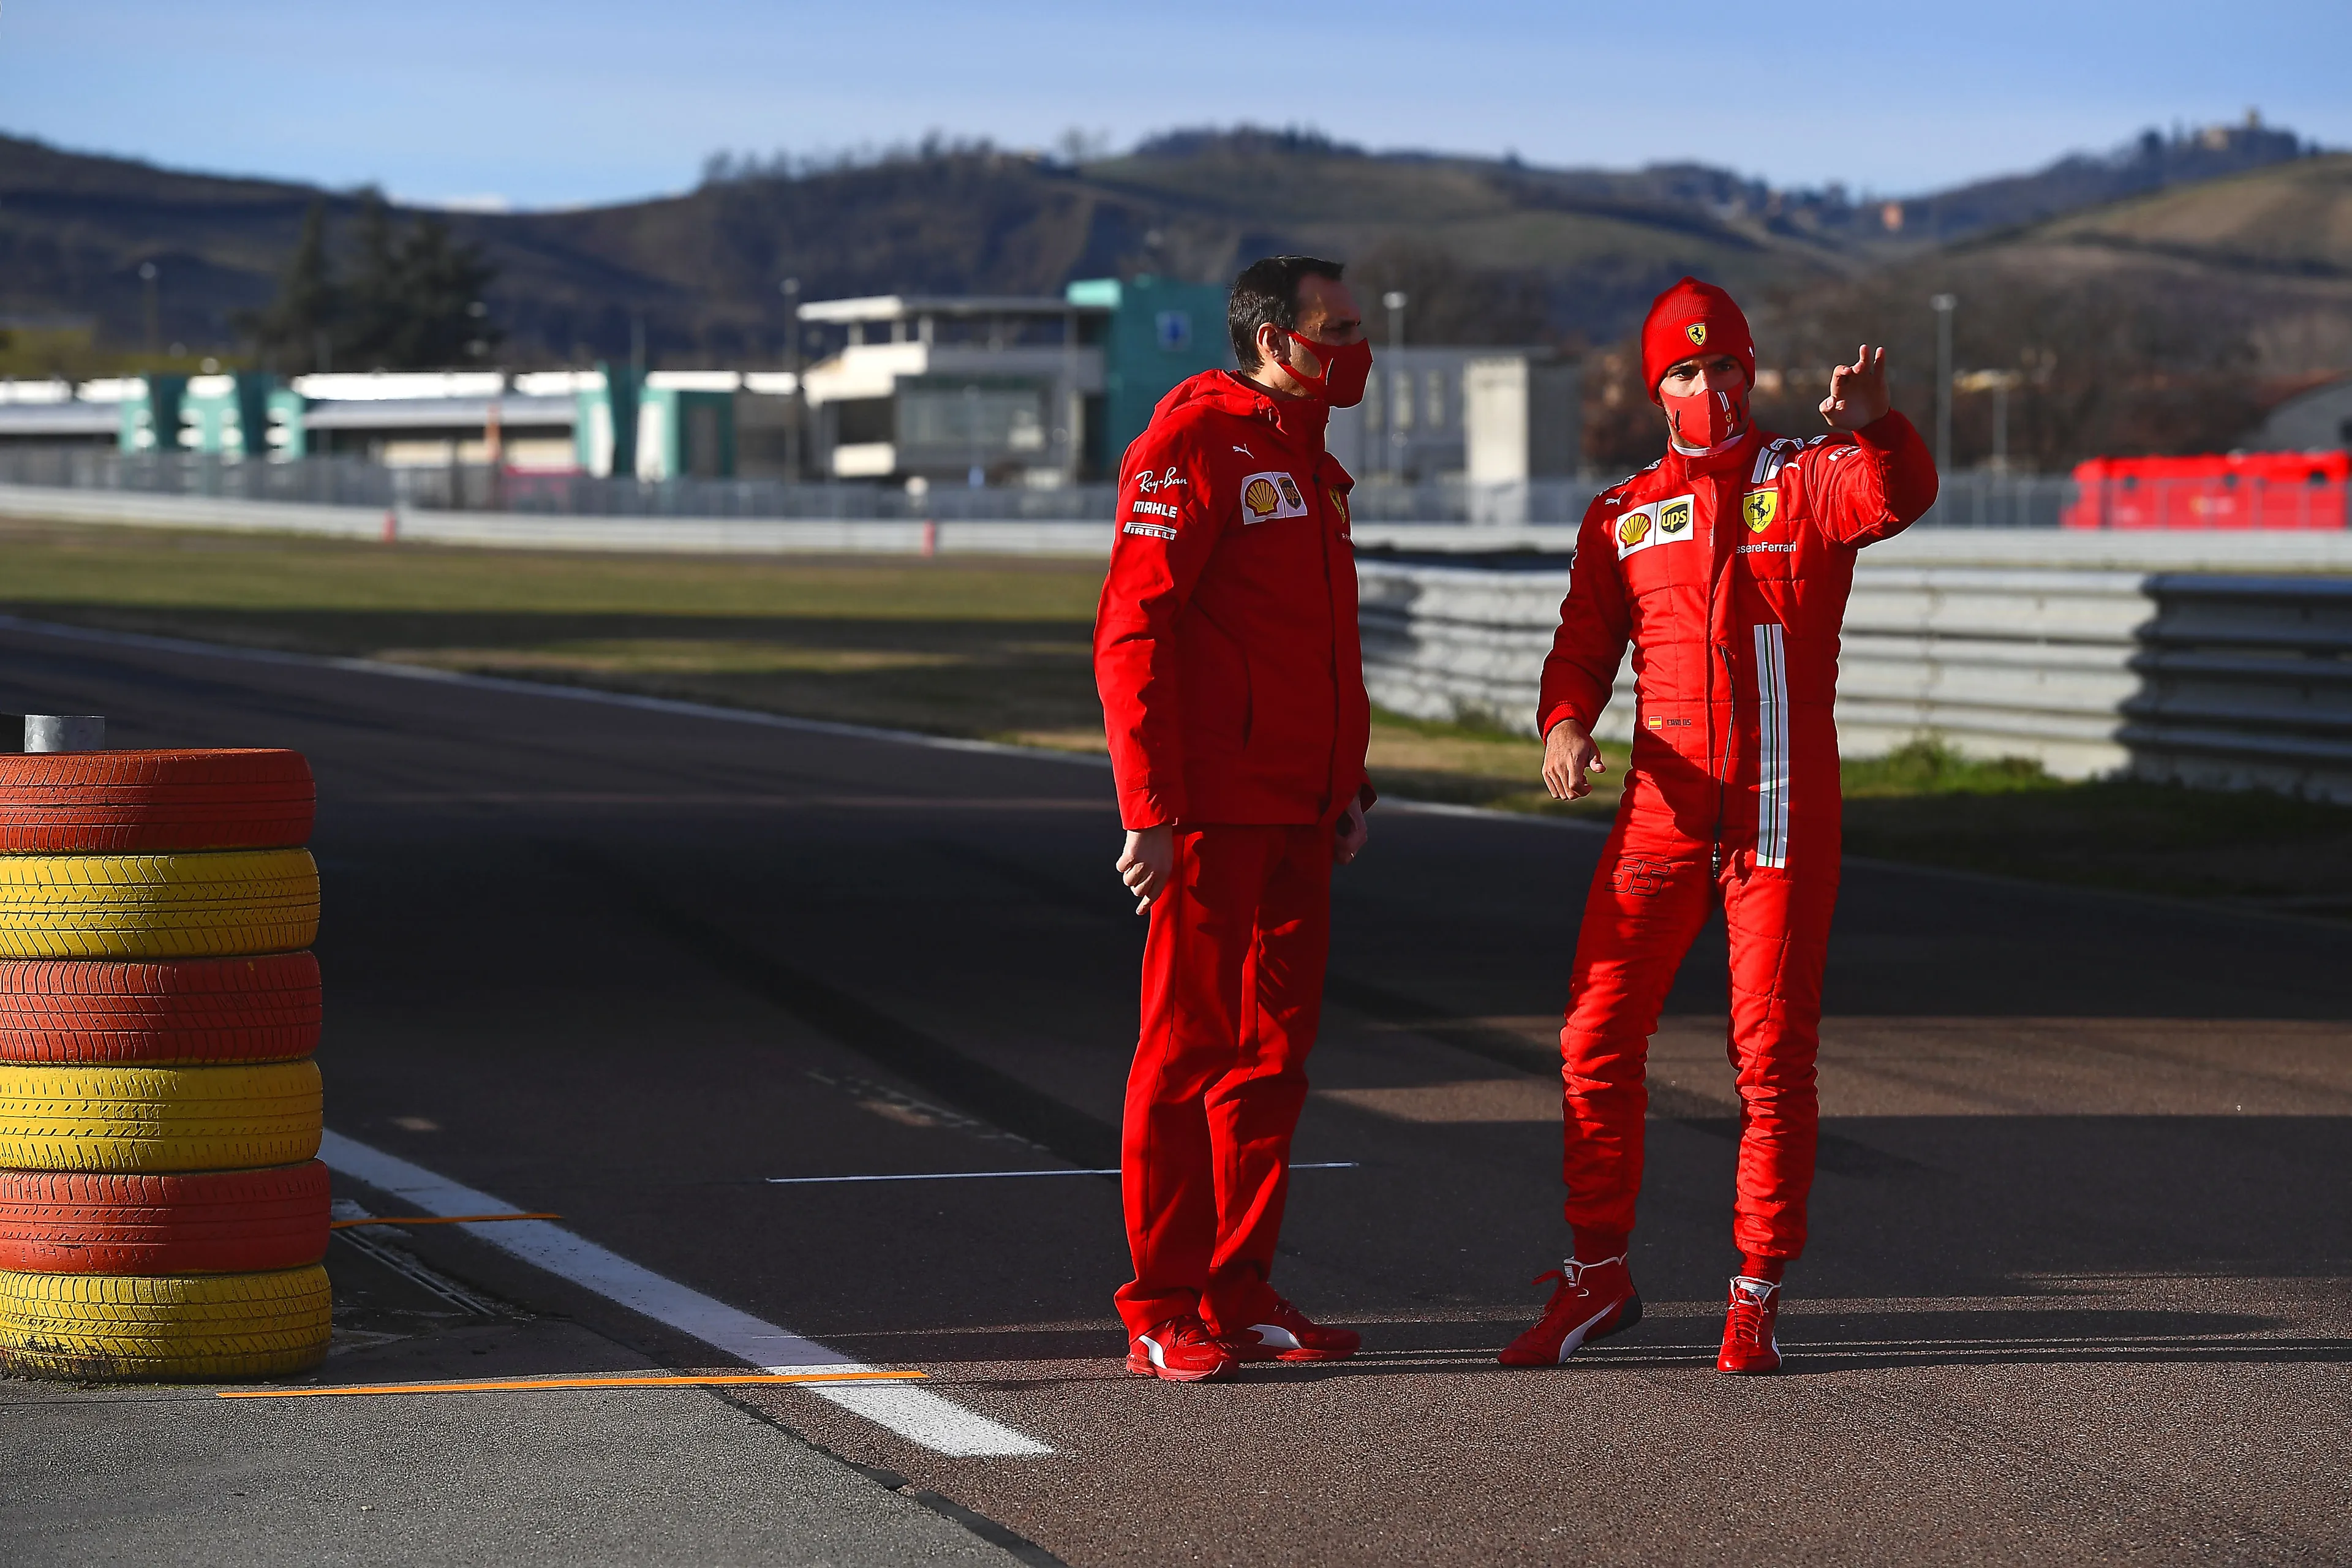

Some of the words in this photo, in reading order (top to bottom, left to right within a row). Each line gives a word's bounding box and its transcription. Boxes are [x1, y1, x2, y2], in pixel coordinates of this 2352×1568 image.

[1133, 500, 1178, 518] MAHLE
[1662, 510, 1687, 530] ups
[1123, 521, 1177, 540] PIRELLI
[1604, 857, 1671, 897] 55
